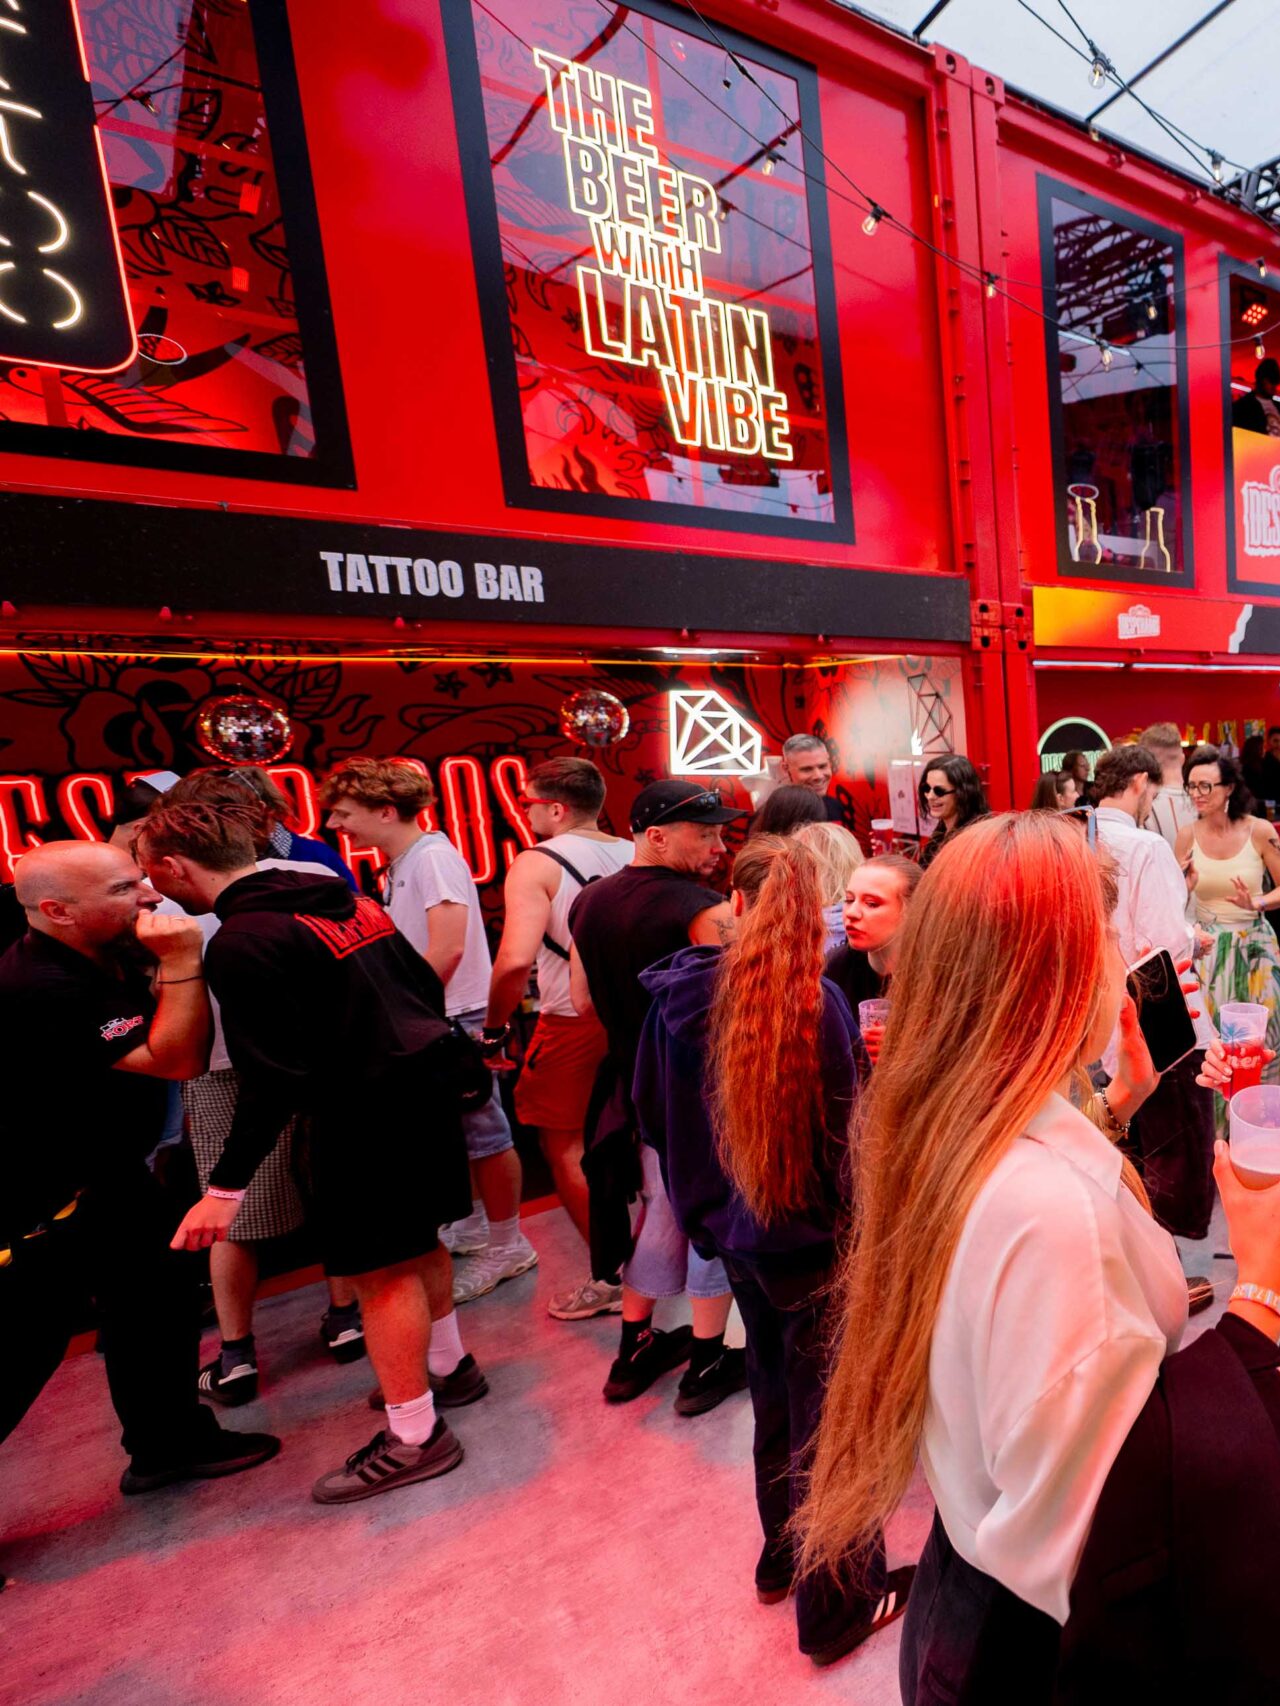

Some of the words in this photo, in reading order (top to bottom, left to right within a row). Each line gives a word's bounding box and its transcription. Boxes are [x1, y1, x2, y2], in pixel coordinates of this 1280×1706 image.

[533, 47, 659, 166] THE
[563, 134, 722, 254] BEER
[589, 217, 704, 299] WITH
[577, 264, 775, 392] LATIN
[660, 368, 793, 461] VIBE
[319, 551, 465, 598] TATTOO
[474, 562, 545, 603] BAR
